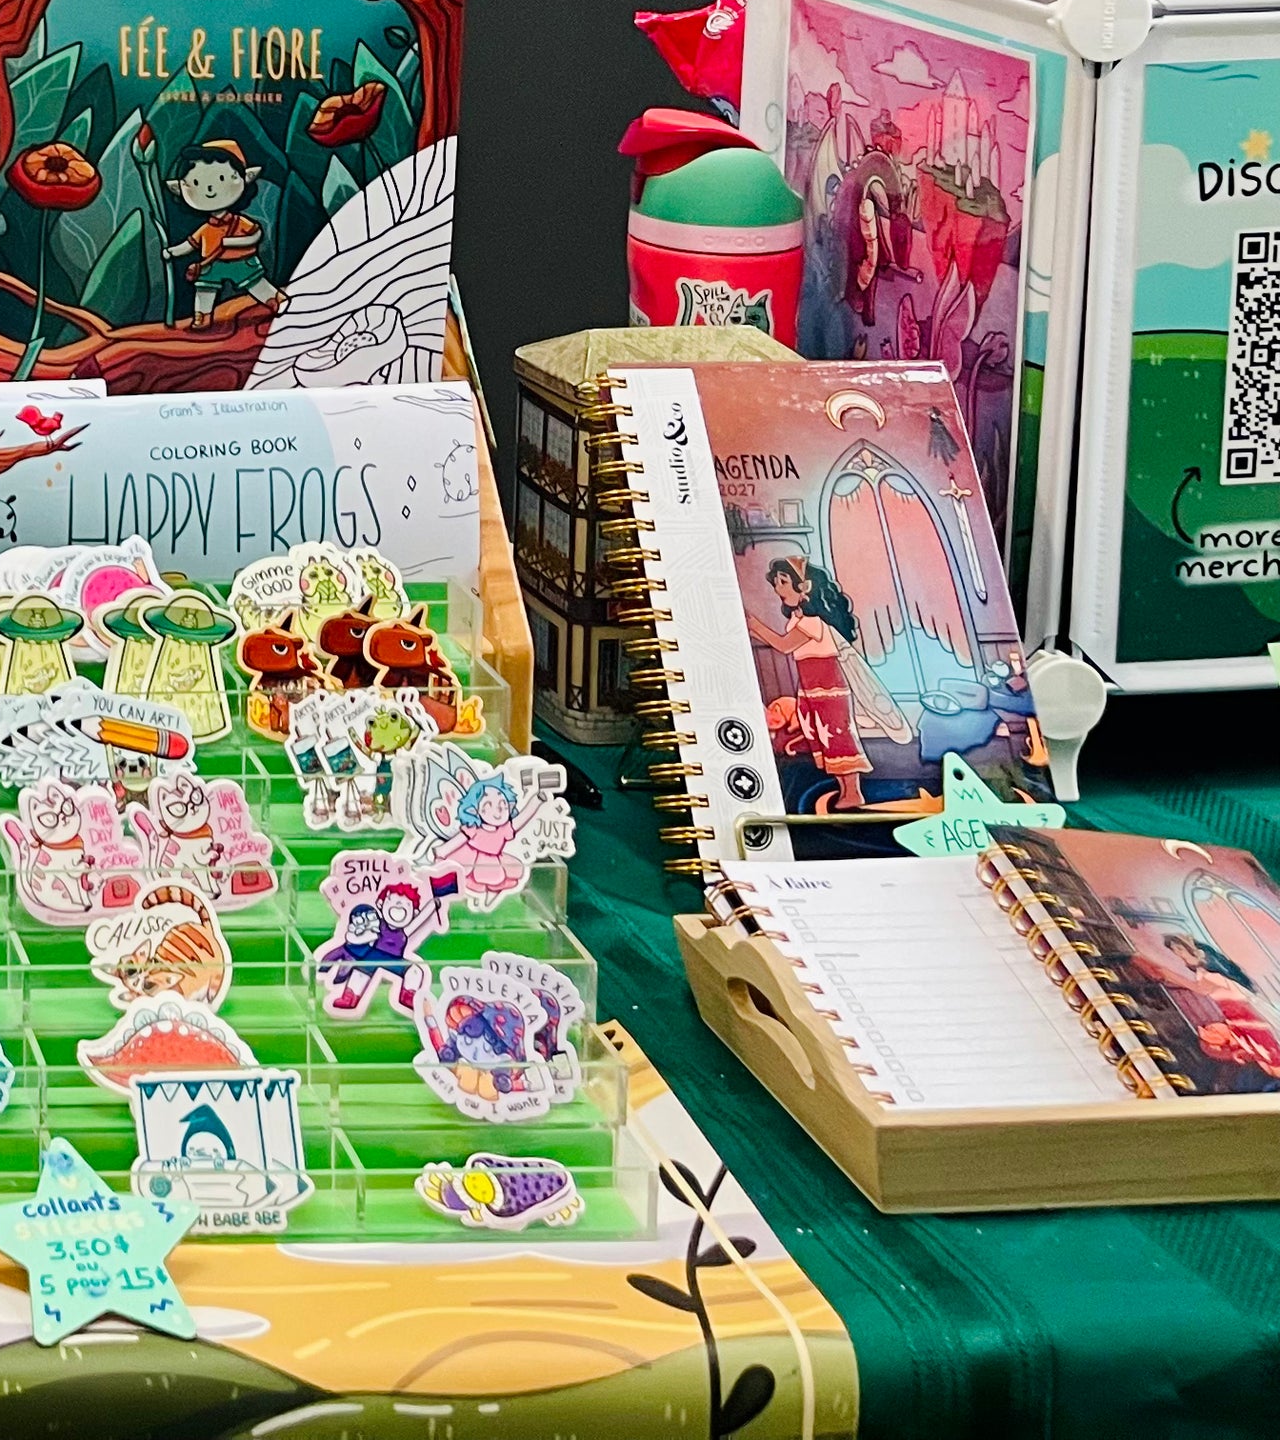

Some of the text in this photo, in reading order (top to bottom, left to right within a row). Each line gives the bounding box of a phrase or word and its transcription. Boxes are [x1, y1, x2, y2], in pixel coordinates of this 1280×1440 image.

[120, 17, 323, 81] FÉE & FLORE
[694, 285, 727, 304] SPILL
[701, 303, 724, 315] TEA
[149, 437, 297, 461] COLORING BOOK
[714, 453, 799, 482] AGENDA
[719, 482, 756, 498] 2027
[70, 465, 378, 557] HAPPY FROGS
[1175, 550, 1279, 578] merch
[93, 695, 180, 729] YOU CAN ART!
[345, 860, 390, 876] STILL
[346, 876, 383, 893] GAY
[448, 975, 539, 1026] DYSLEXIA
[22, 1196, 120, 1218] collants
[41, 1275, 55, 1295] 5
[67, 1275, 111, 1295] pour
